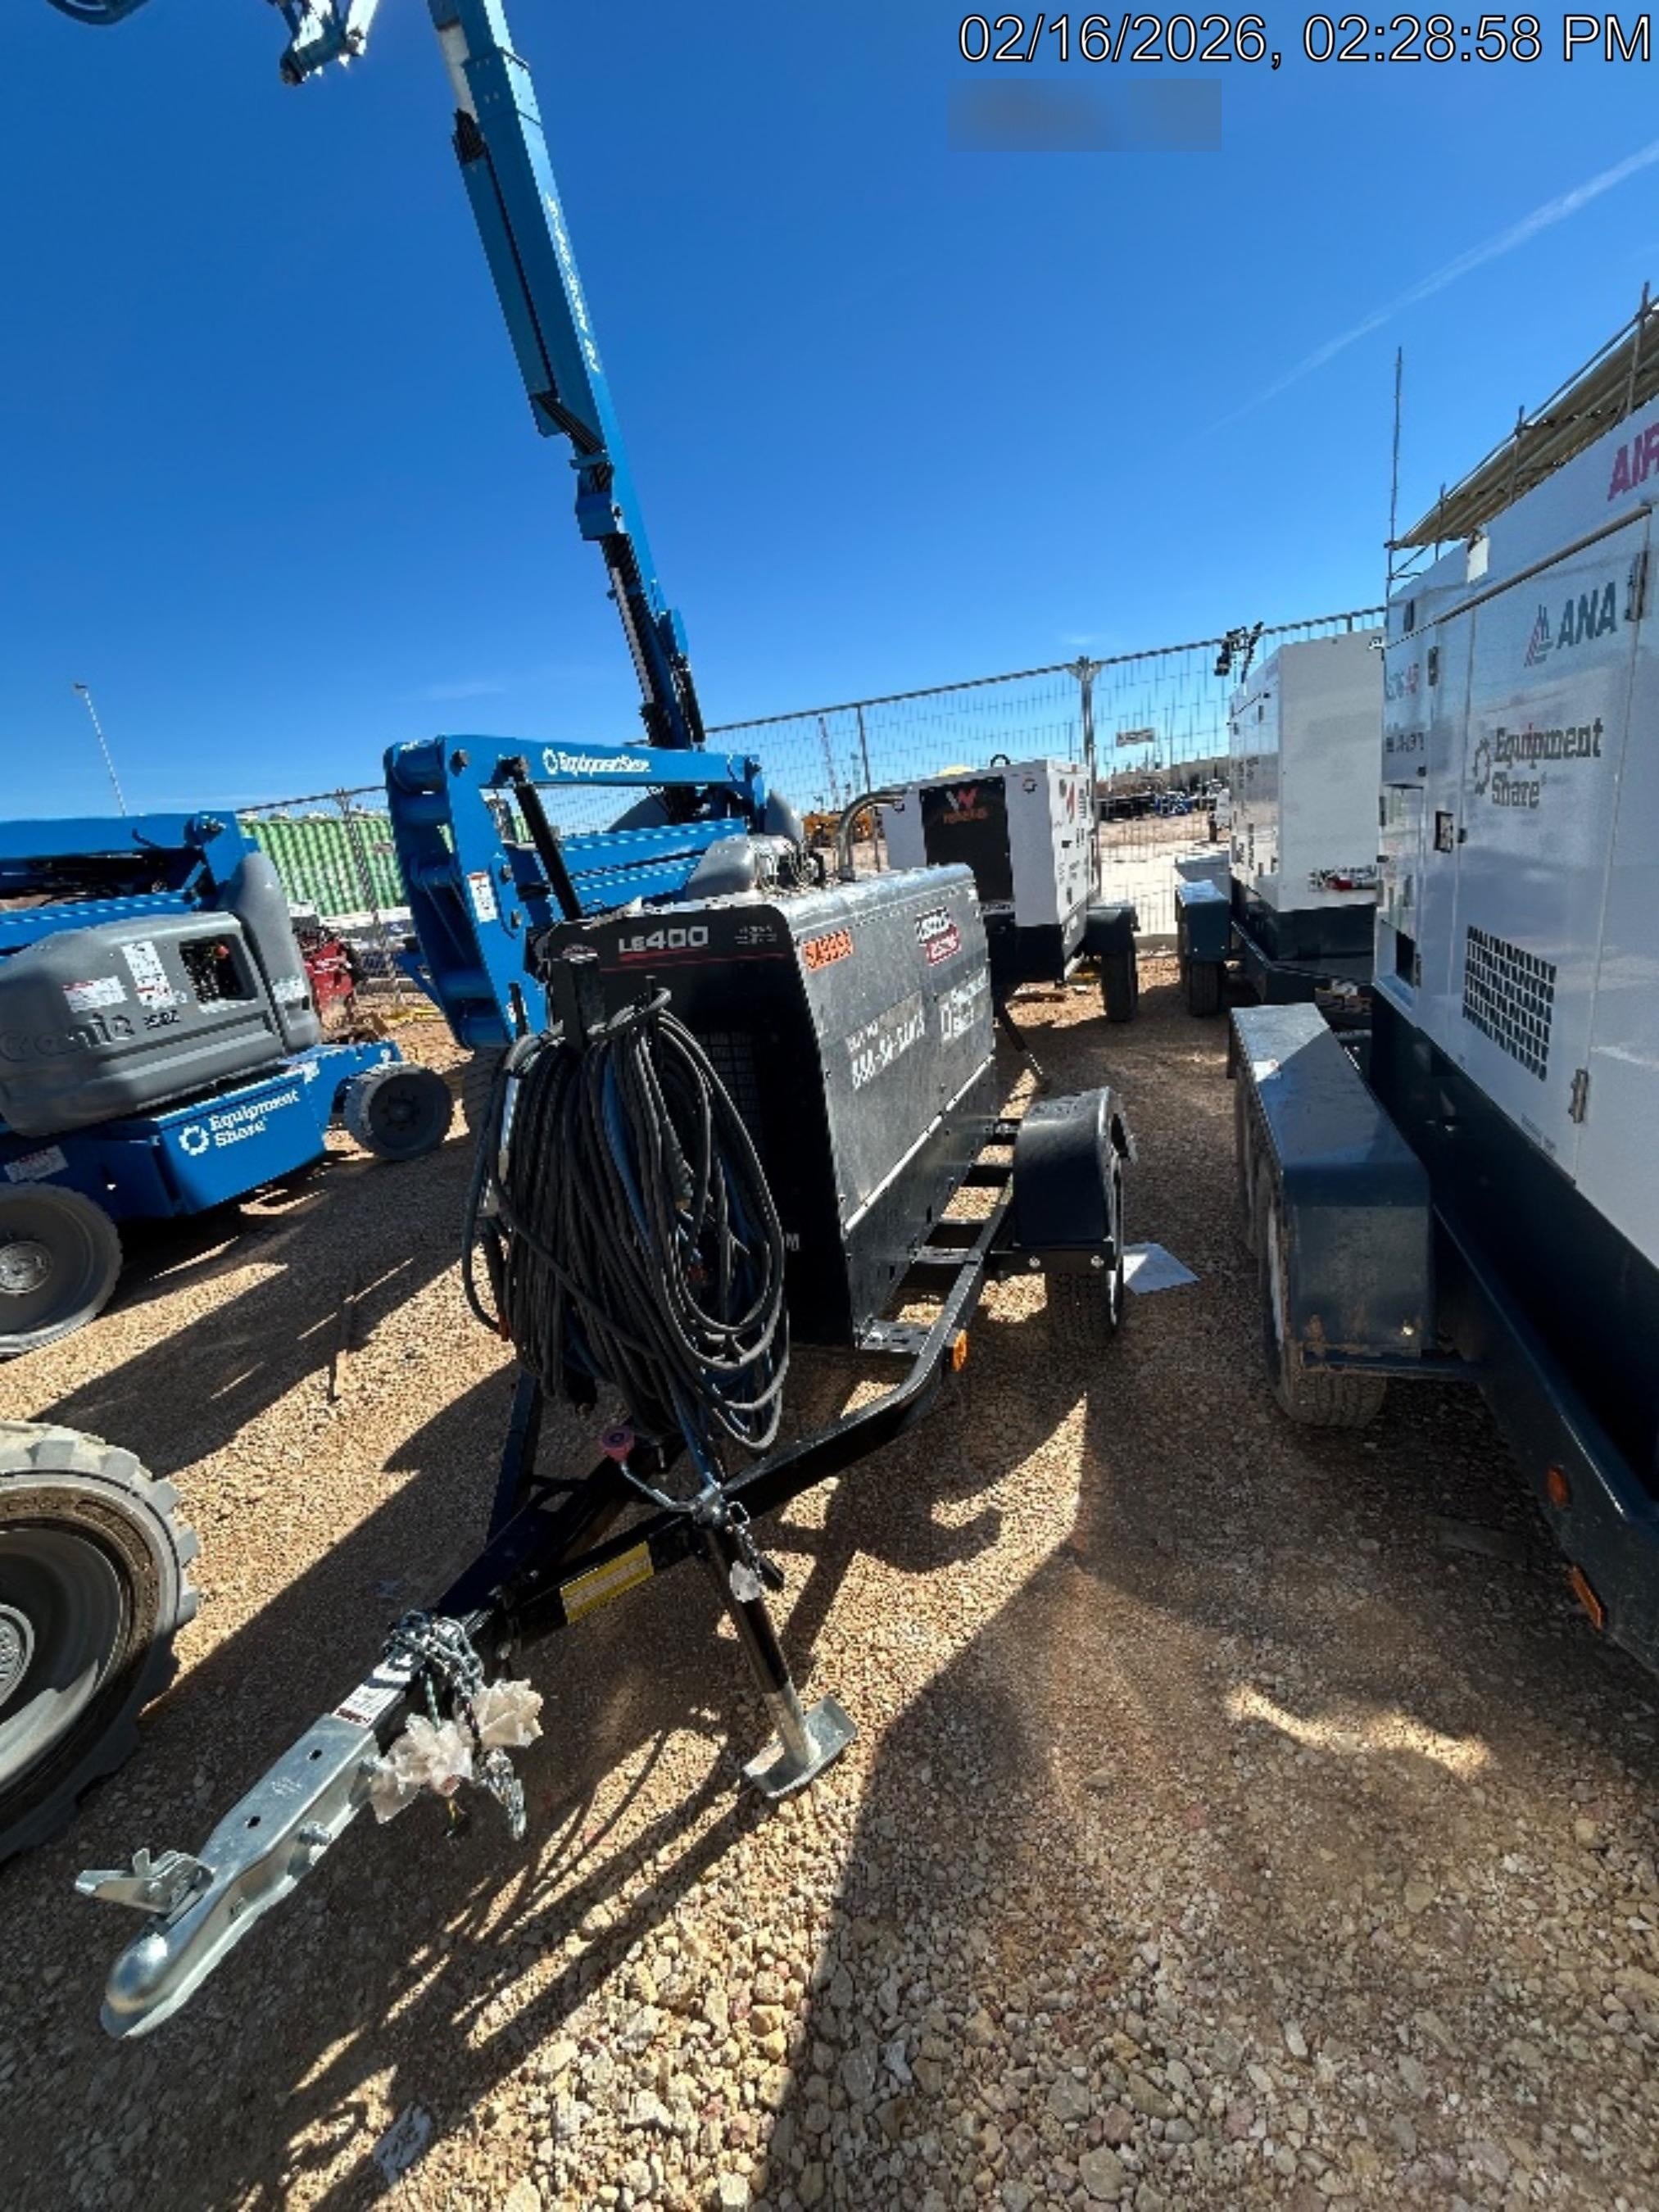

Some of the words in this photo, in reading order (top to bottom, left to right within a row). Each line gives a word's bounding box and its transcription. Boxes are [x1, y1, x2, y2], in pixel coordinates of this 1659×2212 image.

[1557, 581, 1616, 650] ANA
[1493, 716, 1603, 769] Equipment
[1491, 771, 1540, 809] Share
[209, 1088, 301, 1131] Equipment
[214, 1121, 266, 1148] Share
